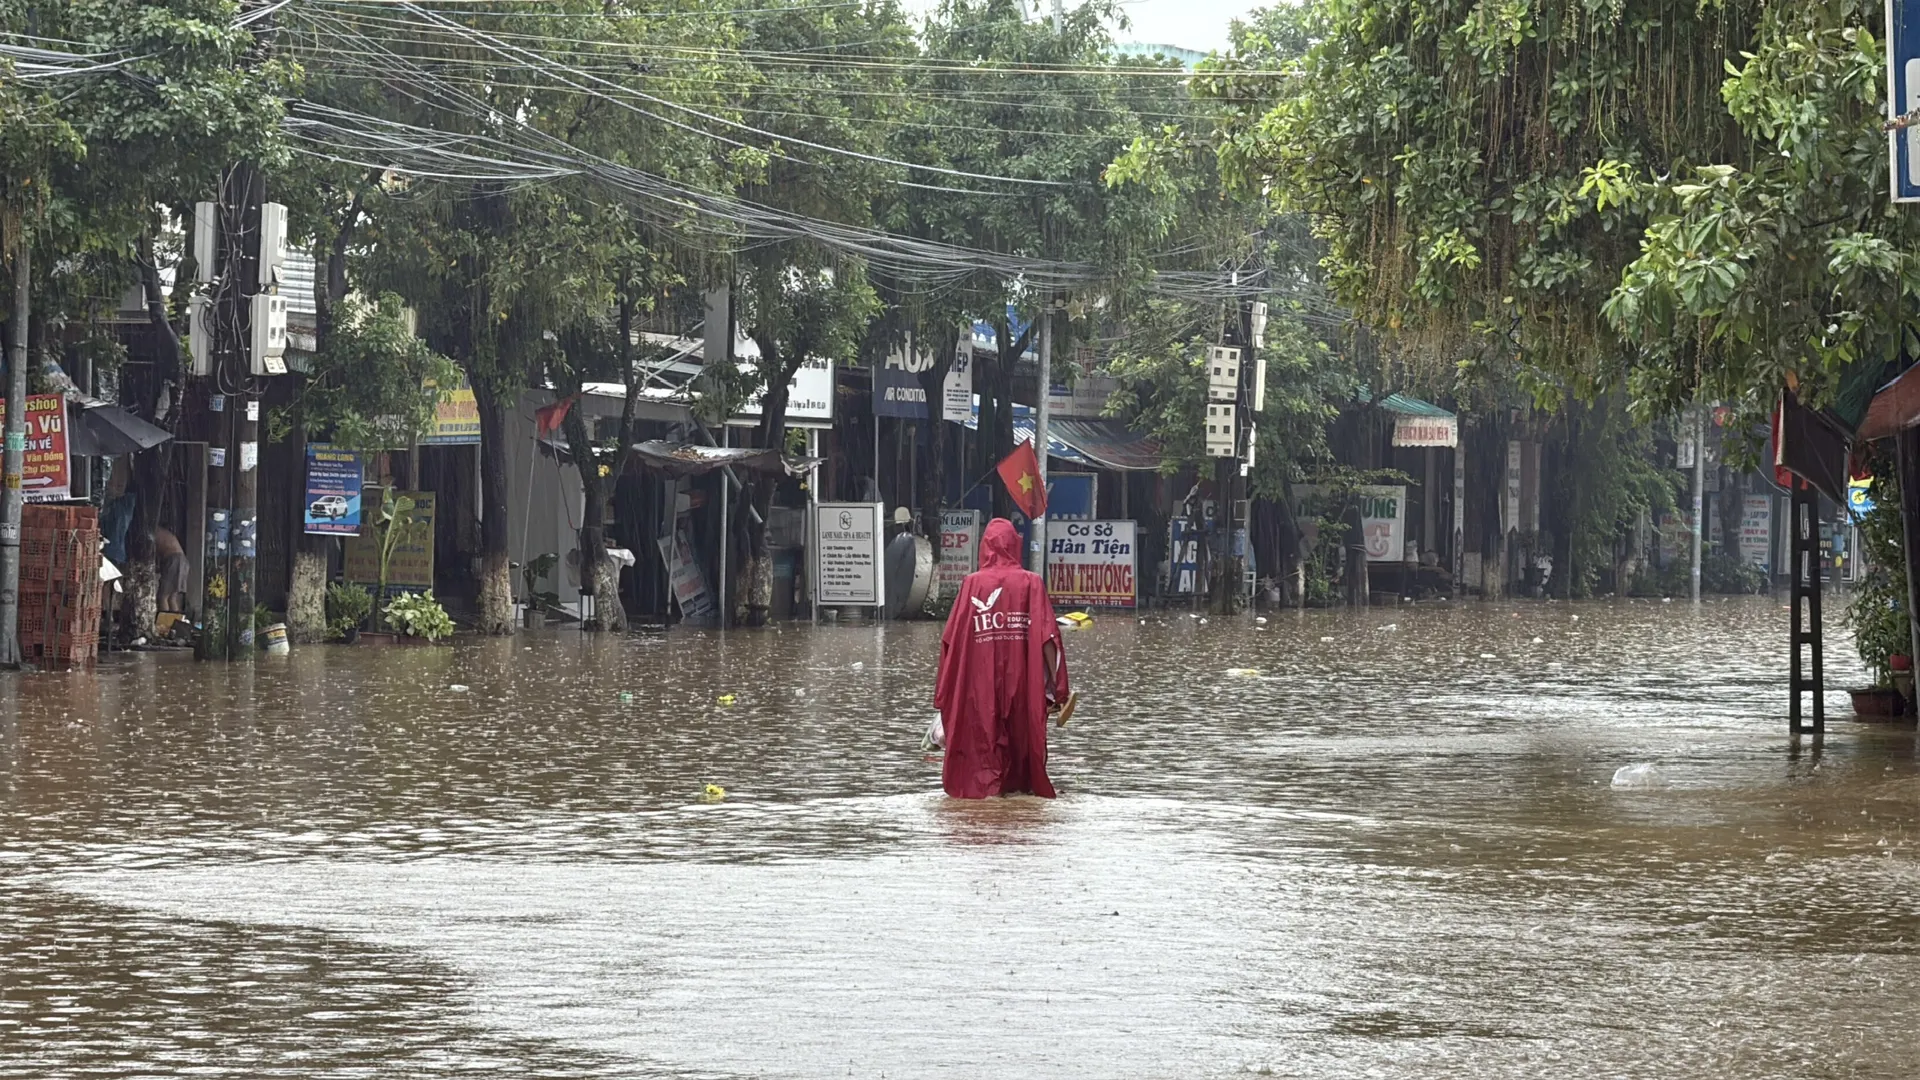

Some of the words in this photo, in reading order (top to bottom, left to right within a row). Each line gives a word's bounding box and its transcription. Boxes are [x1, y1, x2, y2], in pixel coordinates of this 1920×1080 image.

[884, 387, 895, 401] AIR
[38, 414, 62, 434] Vũ
[950, 516, 972, 528] LẠNH
[1067, 524, 1090, 536] Cơ
[1094, 522, 1113, 537] Sở
[1050, 538, 1086, 554] Hàn
[1092, 538, 1130, 559] Tiện
[1048, 557, 1075, 592] VĂN
[973, 611, 1004, 632] IEC
